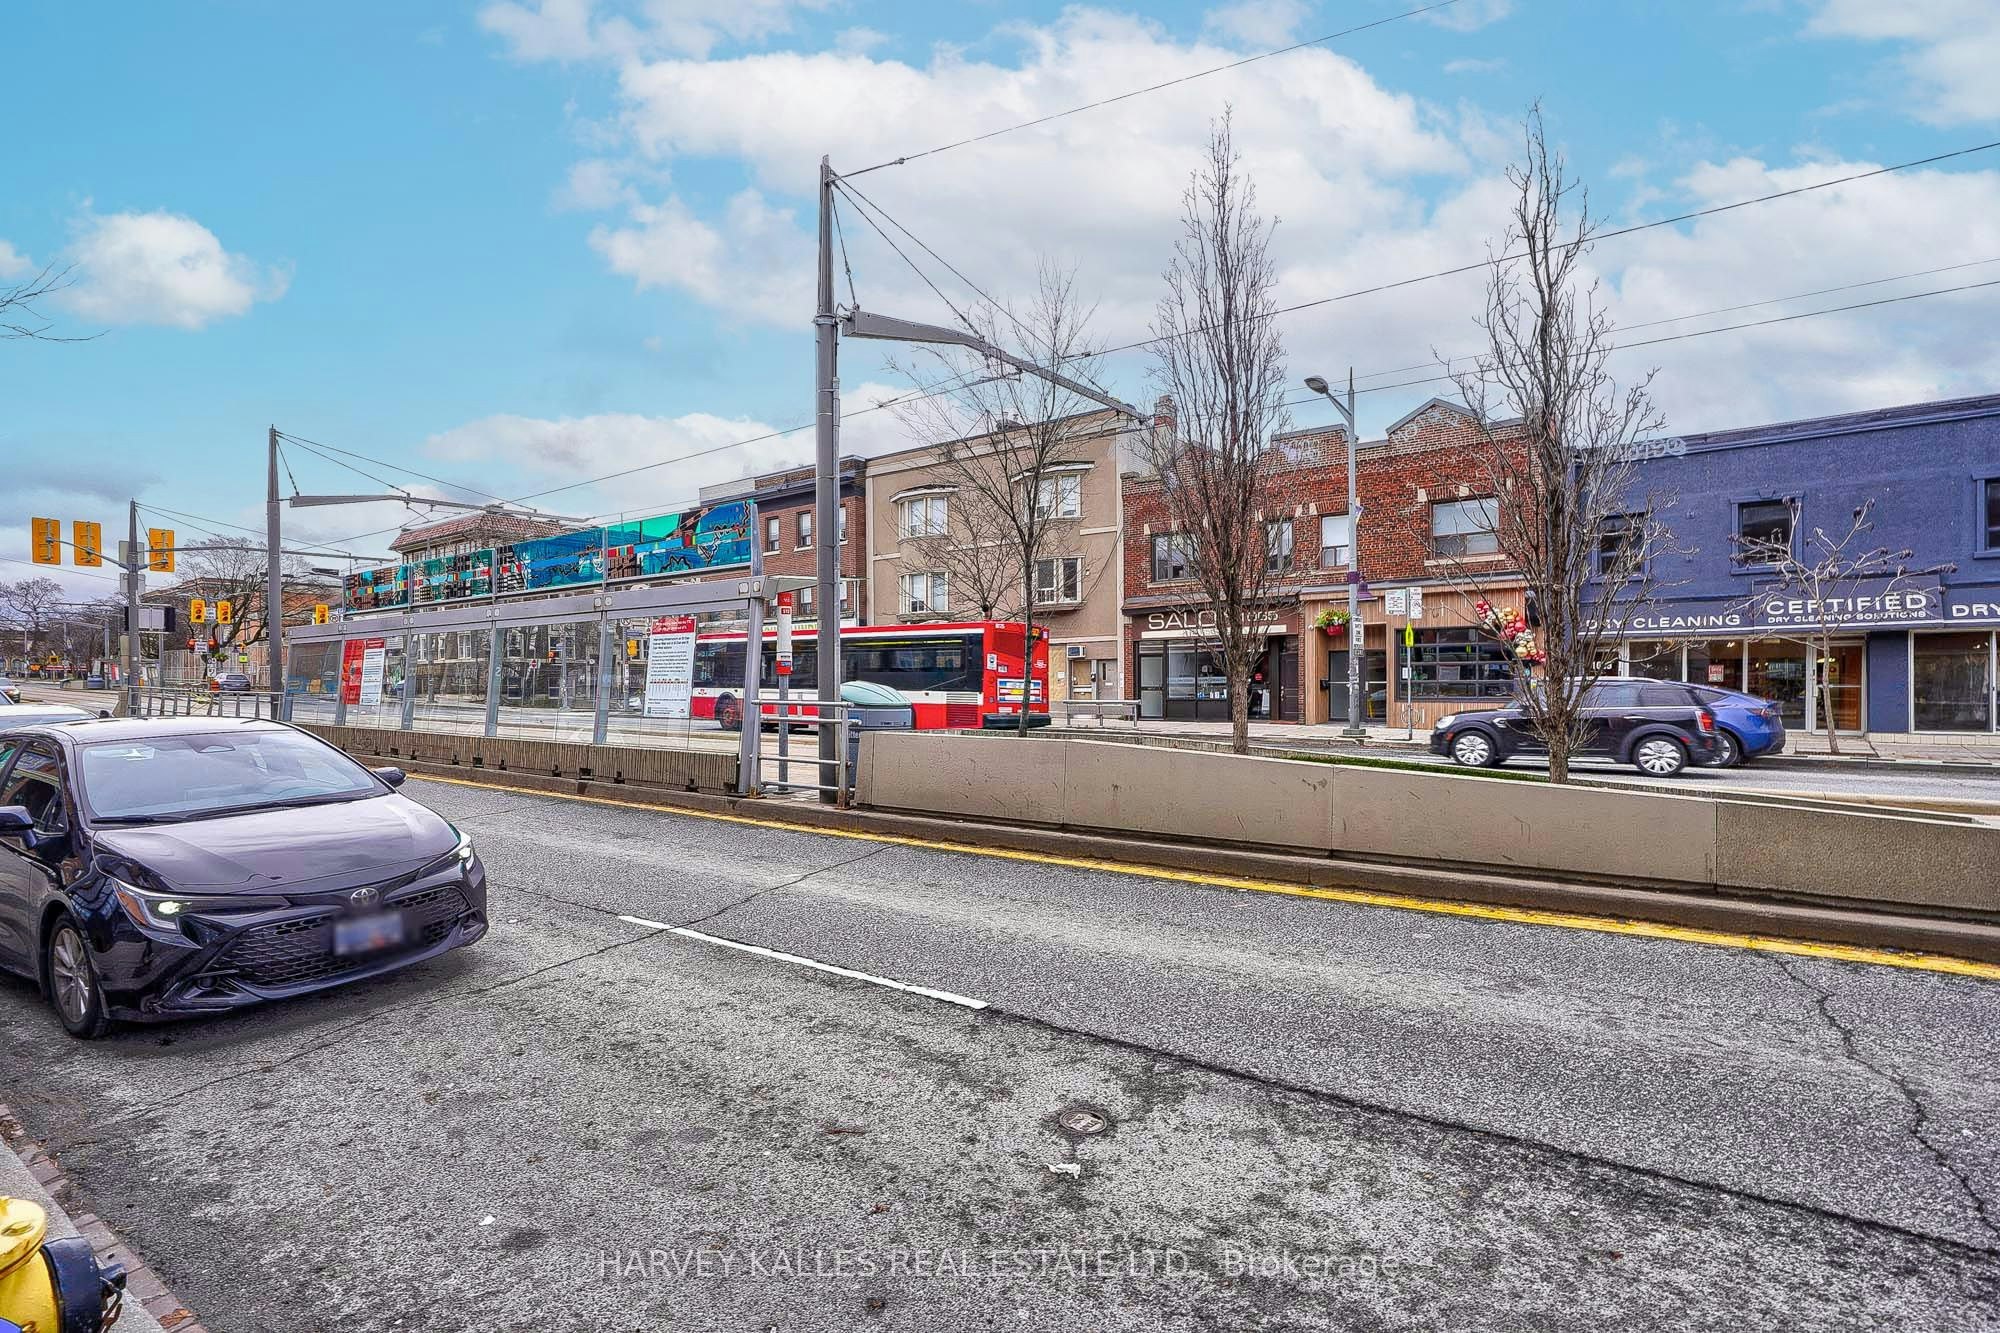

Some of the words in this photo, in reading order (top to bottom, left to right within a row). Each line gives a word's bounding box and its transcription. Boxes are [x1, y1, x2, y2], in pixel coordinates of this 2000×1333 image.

[1766, 594, 1927, 615] CERTIFIED
[1951, 603, 2000, 617] DRY
[1632, 614, 1740, 629] CLEANING
[1767, 616, 1790, 624] DRY
[1856, 610, 1927, 620] SOLUTIONS
